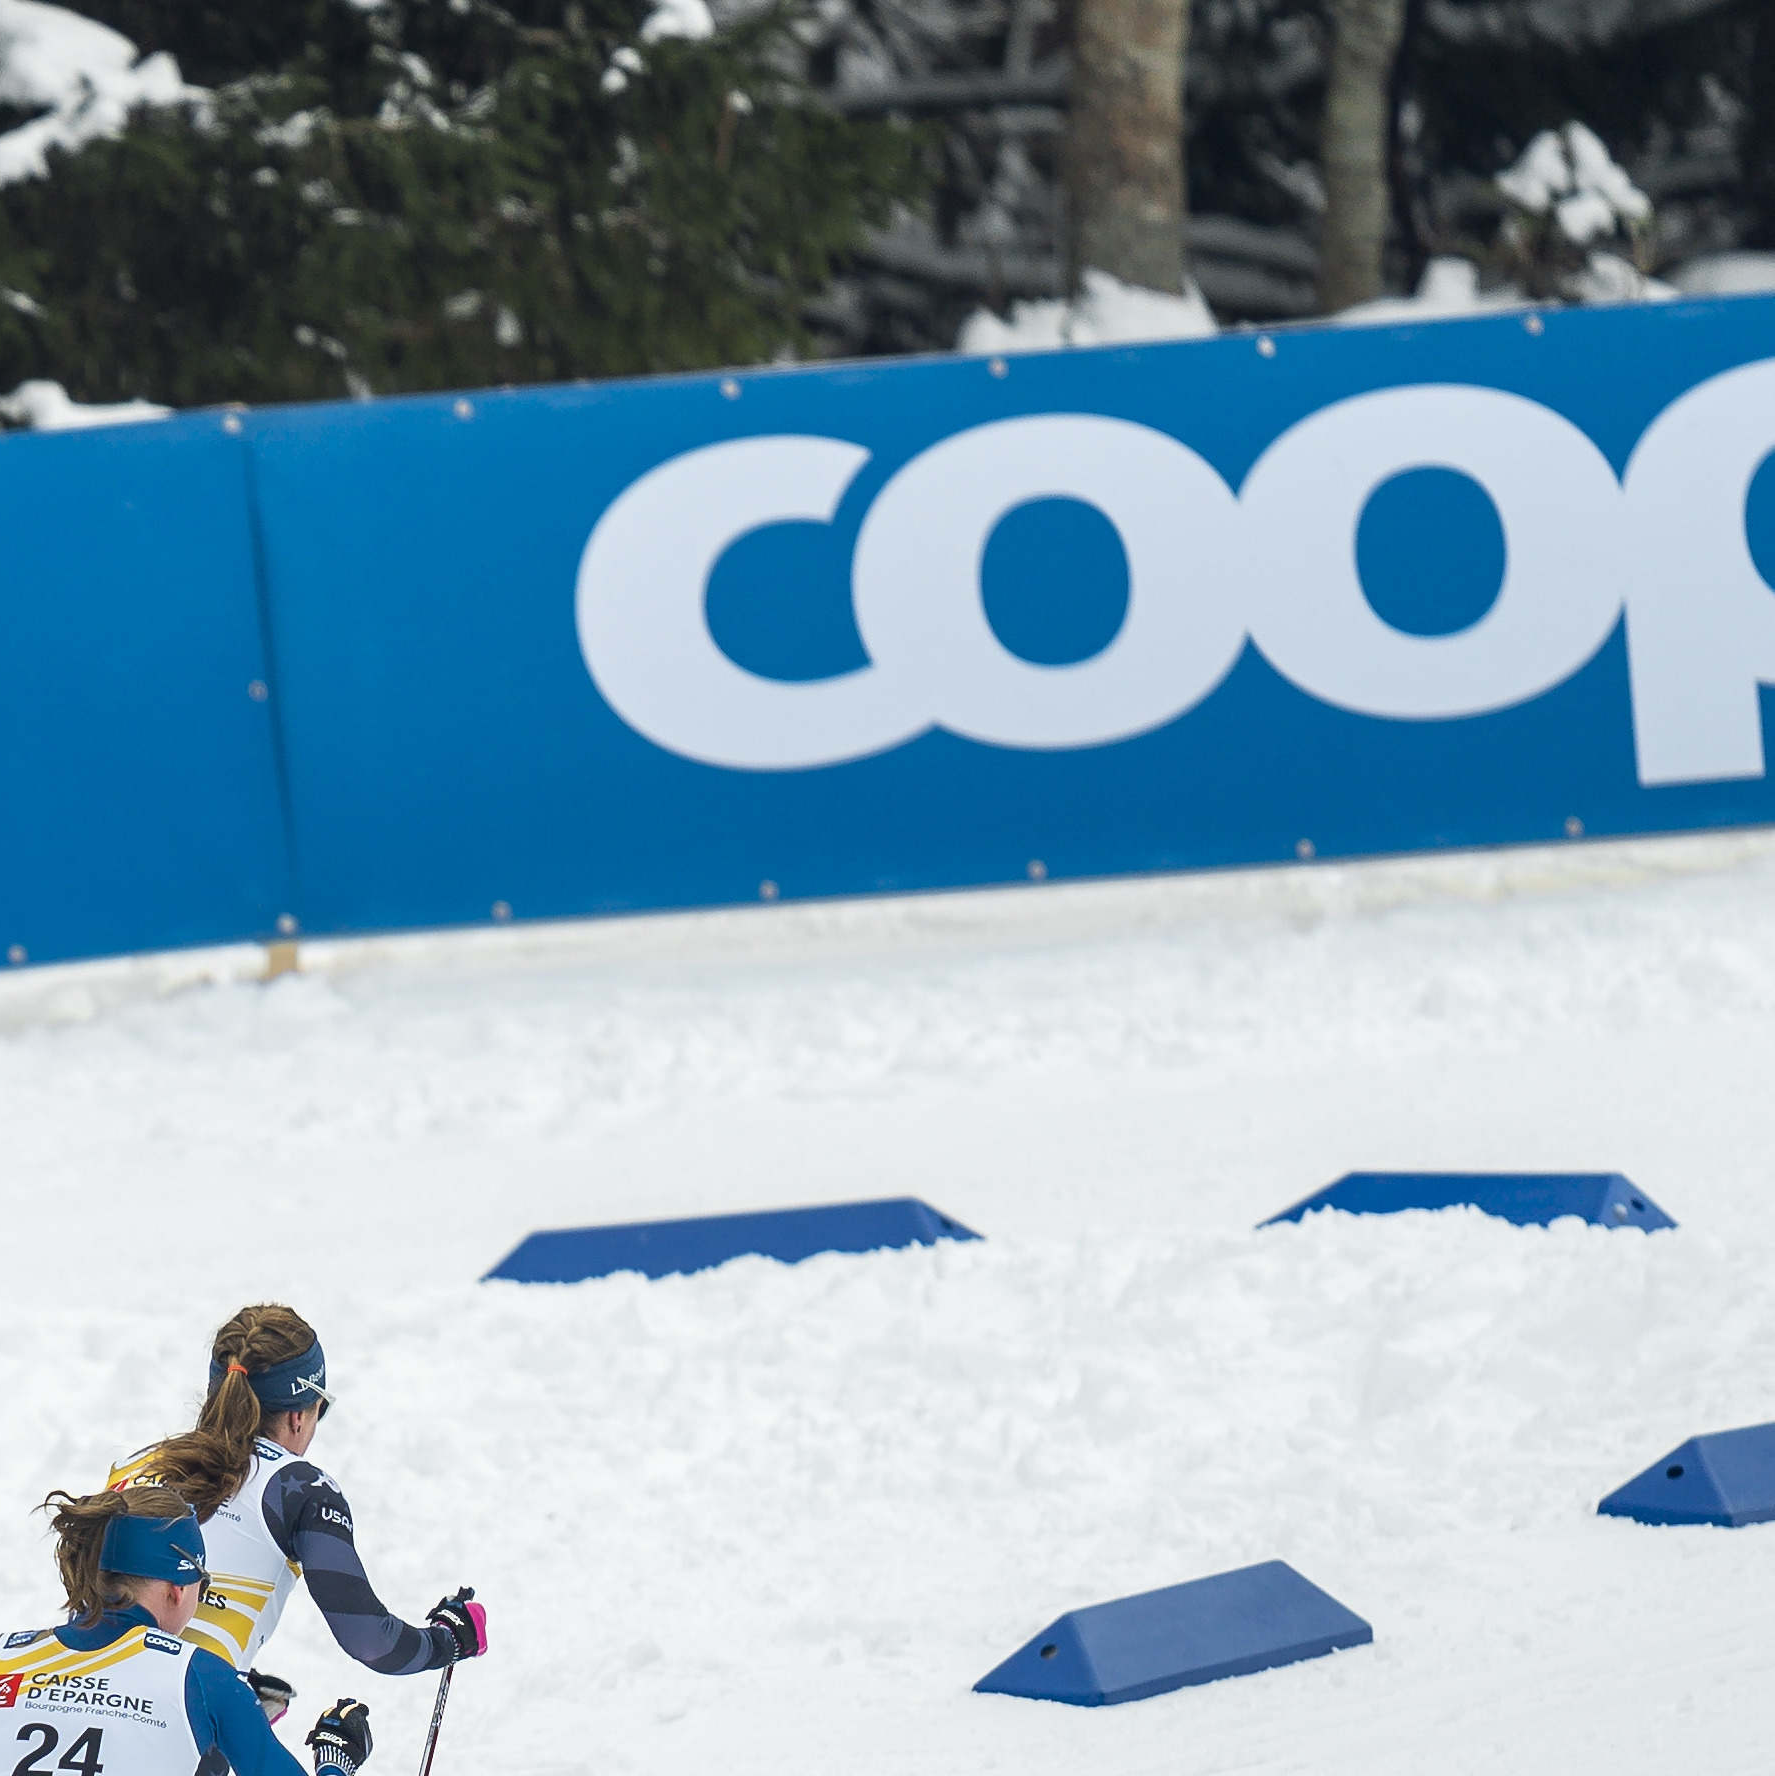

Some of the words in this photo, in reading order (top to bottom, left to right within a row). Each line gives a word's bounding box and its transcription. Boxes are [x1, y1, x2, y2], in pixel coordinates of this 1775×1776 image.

[575, 356, 1775, 784] coop
[145, 1635, 180, 1651] coop
[31, 1672, 110, 1691] CAISSE
[27, 1687, 154, 1715] D'EPARGNE
[24, 1701, 83, 1714] Bourgogne
[84, 1706, 167, 1729] Franche-Comté
[315, 1730, 349, 1748] SWIX
